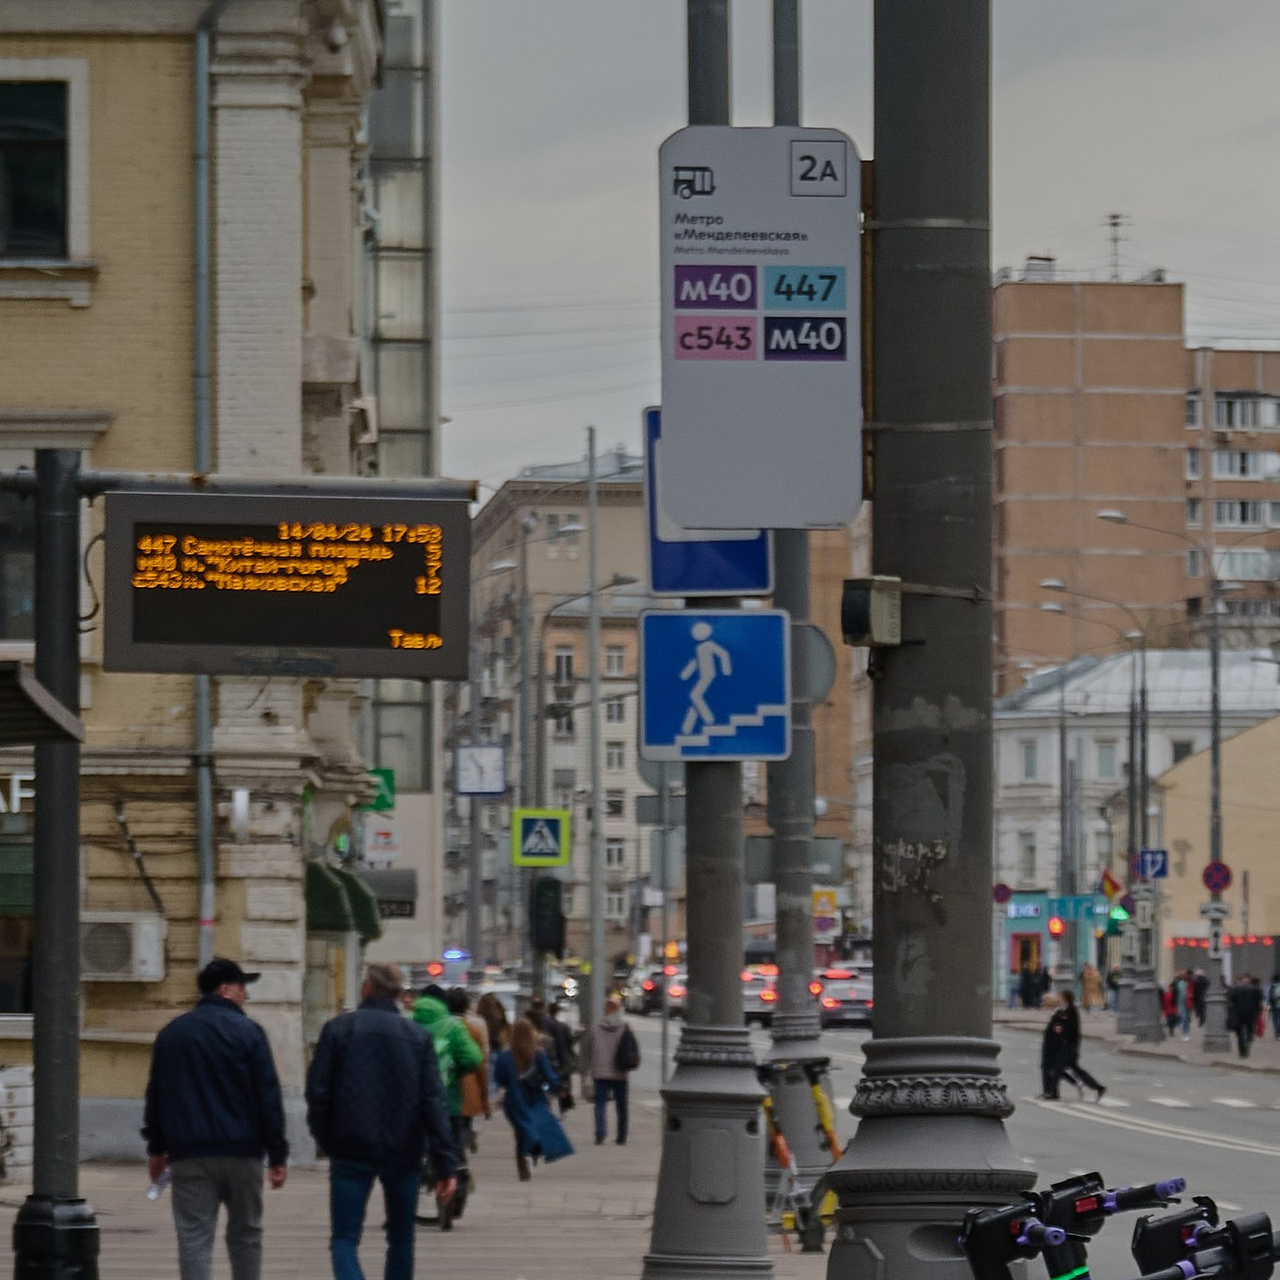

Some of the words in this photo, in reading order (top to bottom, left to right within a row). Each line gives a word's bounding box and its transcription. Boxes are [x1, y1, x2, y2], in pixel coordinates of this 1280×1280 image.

[674, 213, 725, 227] Метро
[674, 228, 809, 242] «Менделеевская»
[774, 273, 838, 302] 447
[679, 326, 753, 350] с543
[137, 535, 178, 554] 447
[425, 543, 443, 560] 5
[425, 560, 443, 577] 7
[414, 576, 443, 594] 12
